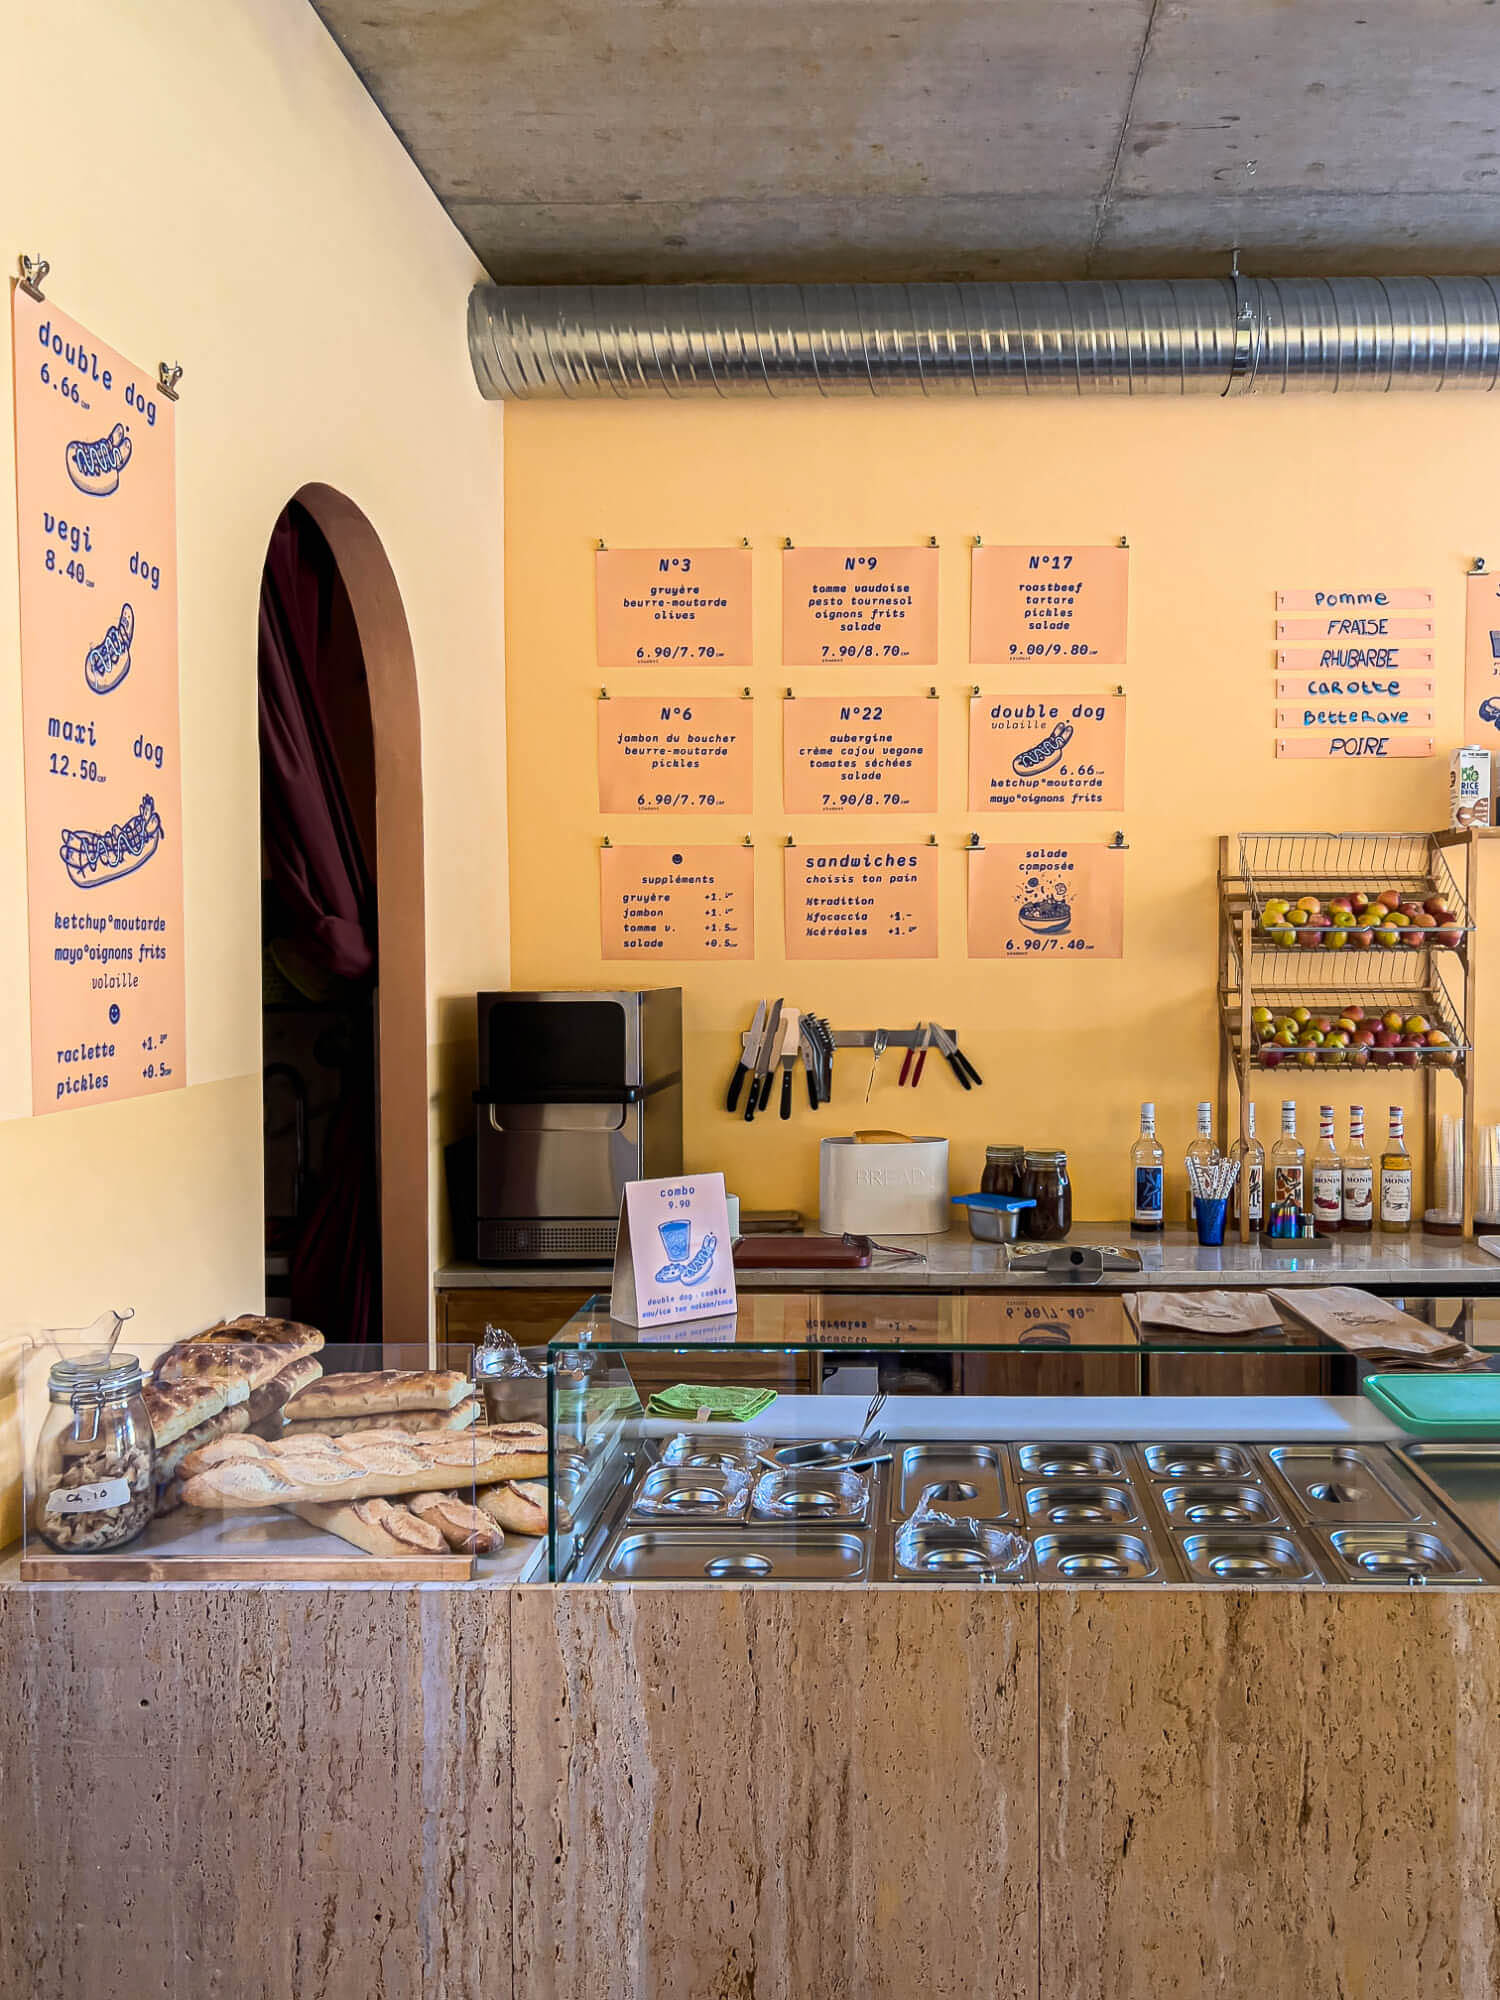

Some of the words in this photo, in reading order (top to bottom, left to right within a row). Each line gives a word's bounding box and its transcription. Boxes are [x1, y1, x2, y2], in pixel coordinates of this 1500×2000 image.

[37, 320, 114, 392] double
[124, 382, 157, 427] dog
[40, 362, 80, 405] 6.66
[42, 512, 93, 553] vegi
[129, 551, 161, 591] dog
[44, 548, 86, 585] 8.40
[660, 559, 690, 571] N°3
[845, 557, 877, 570] N°9
[1029, 556, 1072, 569] N°17
[651, 586, 699, 596] gruyère
[813, 585, 846, 593] tomme
[855, 584, 909, 592] vaudoise
[1020, 583, 1082, 593] roastbeef
[624, 598, 726, 607] beurre-moutarde
[809, 598, 842, 607] pesto
[852, 596, 911, 605] tournesol
[1027, 596, 1073, 604] tartare
[1315, 592, 1391, 607] Pomme
[655, 610, 695, 619] olives
[816, 610, 862, 620] oignons
[871, 609, 904, 620] frits
[1025, 608, 1072, 618] pickles
[840, 622, 880, 631] salade
[1029, 621, 1069, 629] salade
[1327, 619, 1389, 635] FRAISE
[636, 646, 715, 659] 6.90/7.70
[822, 645, 900, 658] 7.90/8.70
[1009, 644, 1089, 657] 9.00/9.80
[1320, 649, 1400, 669] RHUBARBE
[661, 708, 691, 720] N°6
[841, 707, 882, 720] N°22
[991, 704, 1058, 718] double
[1072, 704, 1104, 720] dog
[991, 720, 1047, 729] volaille
[47, 716, 98, 748] maxi
[133, 735, 165, 769] dog
[618, 733, 658, 744] jambon
[667, 734, 679, 742] du
[688, 734, 736, 742] boucher
[830, 734, 892, 744] aubergine
[625, 747, 727, 755] beurre-moutarde
[800, 747, 832, 755] crème
[841, 746, 874, 756] cajou
[883, 748, 923, 756] vegane
[1329, 737, 1390, 756] POIRE
[49, 753, 98, 782] 12.50
[652, 759, 699, 769] pickles
[866, 758, 912, 767] séchées
[842, 771, 881, 780] salade
[1060, 765, 1095, 776] 6.66
[637, 794, 715, 807] 6.90/7.70
[822, 794, 900, 807] 7.90/8.70
[1072, 794, 1102, 804] frits
[1026, 849, 1067, 857] salade
[806, 854, 916, 867] sandwiches
[1019, 862, 1074, 872] composée
[642, 875, 714, 885] suppléments
[807, 875, 854, 883] choisis
[890, 874, 917, 883] pain
[623, 894, 670, 903] gruyère
[624, 908, 663, 918] jambon
[624, 939, 663, 947] salade
[1006, 939, 1085, 952] 6.90/7.40
[138, 944, 167, 962] frits
[91, 973, 139, 991] volaille
[56, 1041, 116, 1065] raclette
[56, 1073, 109, 1100] pickles
[660, 1185, 696, 1198] combo
[668, 1200, 690, 1209] 9.90
